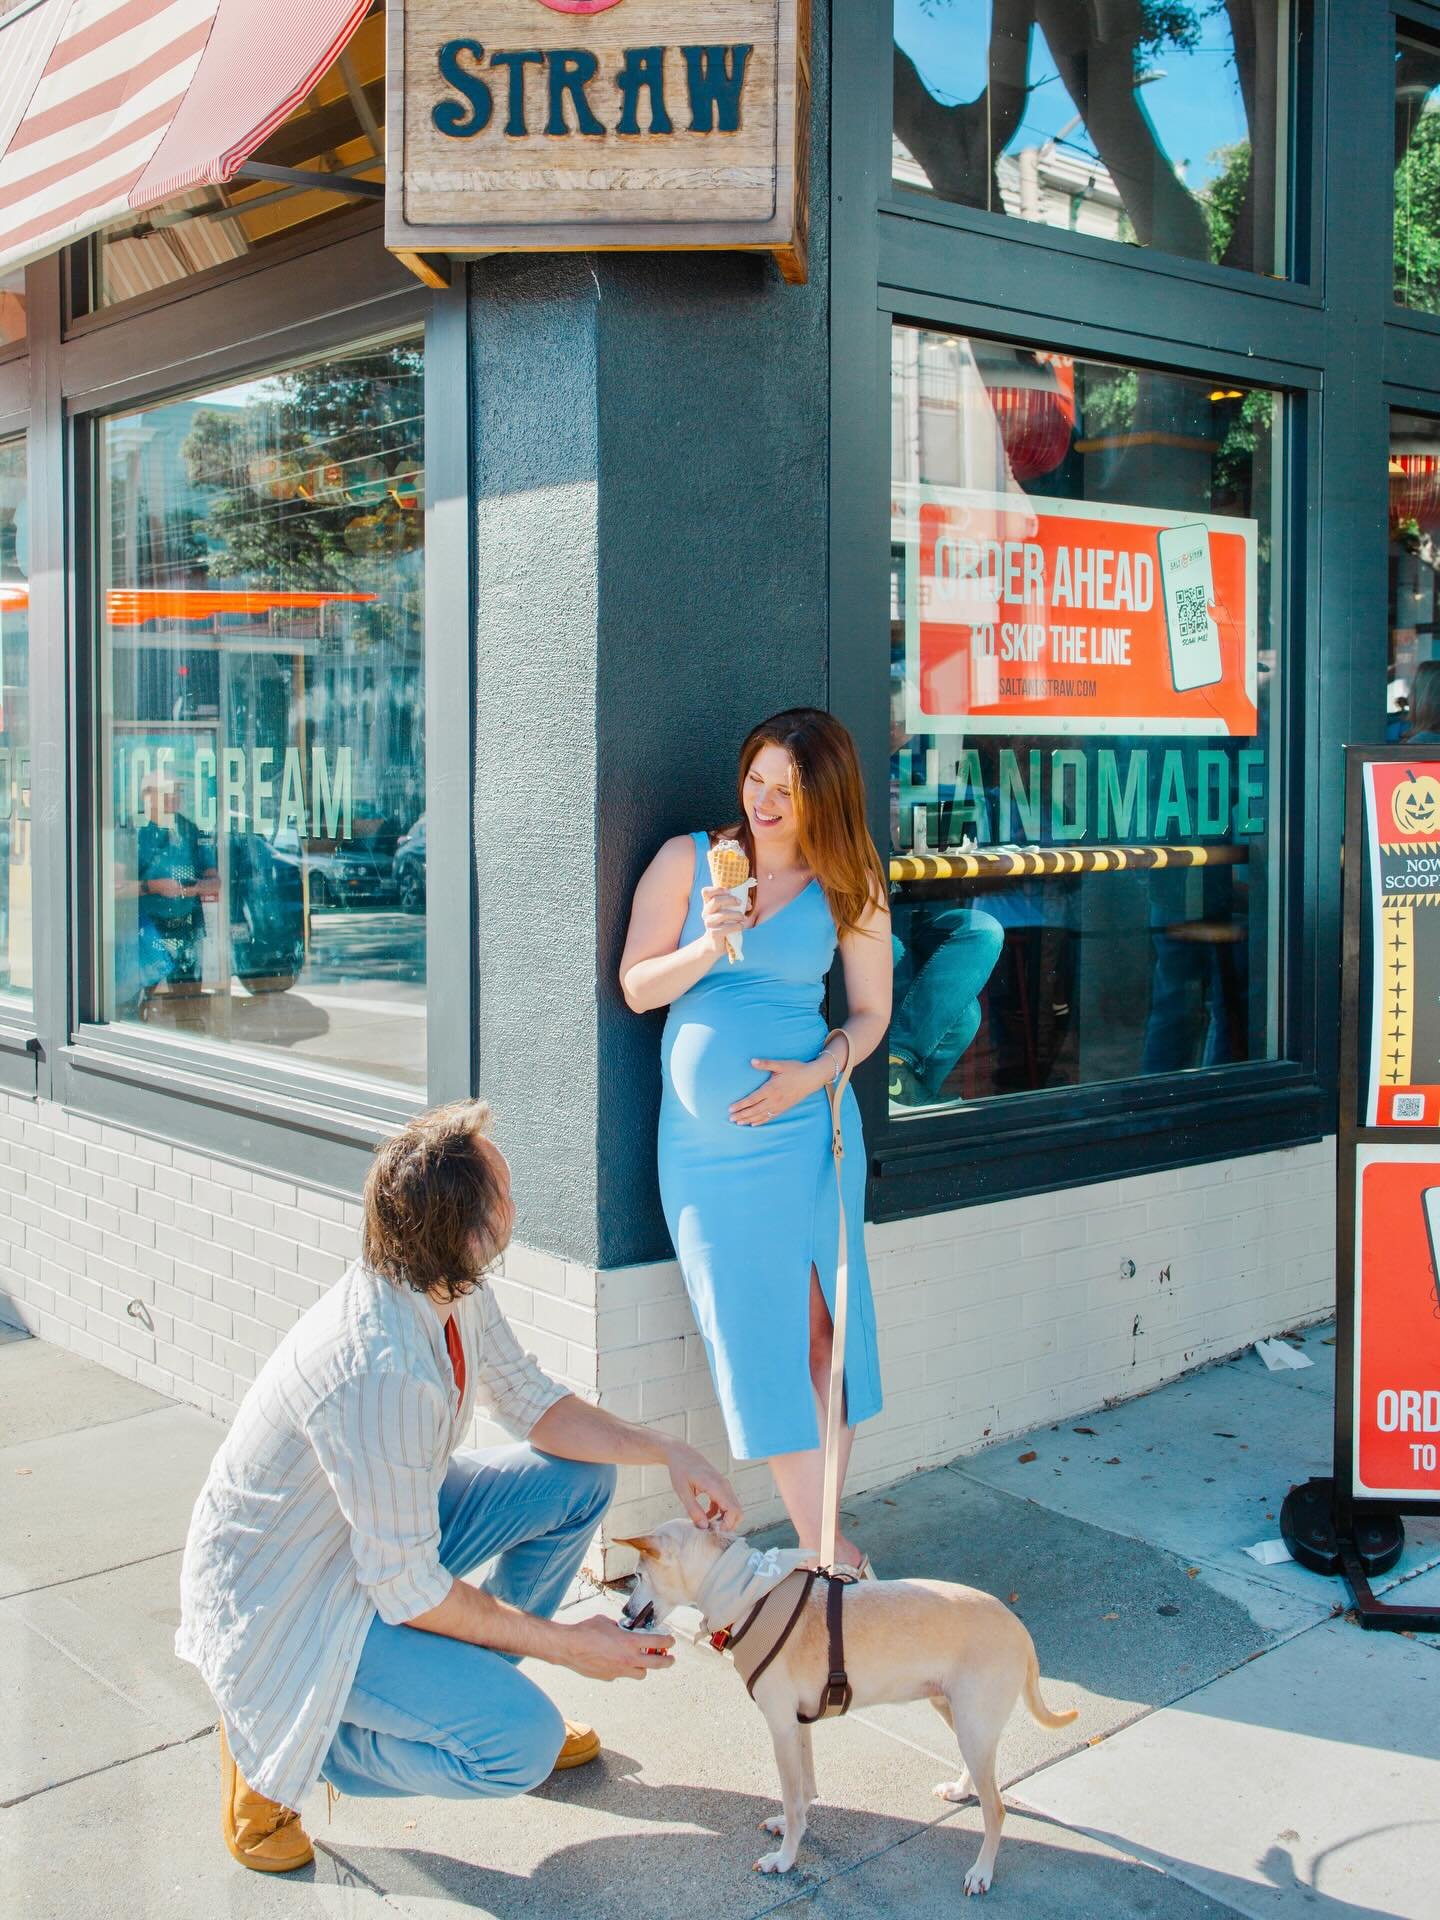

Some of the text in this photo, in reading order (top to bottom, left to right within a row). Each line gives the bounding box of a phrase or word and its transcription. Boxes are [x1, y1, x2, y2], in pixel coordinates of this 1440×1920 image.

[432, 38, 753, 138] STRAW
[934, 536, 1153, 613] ORDER AHEAD
[968, 622, 1131, 665] TO SKIP THE LINE
[999, 678, 1097, 697] SALTANDSTRAW.COM
[118, 746, 353, 840] ICE CREAM
[898, 749, 1265, 847] HANDMADE
[1385, 874, 1440, 889] SCOOP
[1376, 1389, 1440, 1432] ORD
[1409, 1443, 1437, 1471] TO
